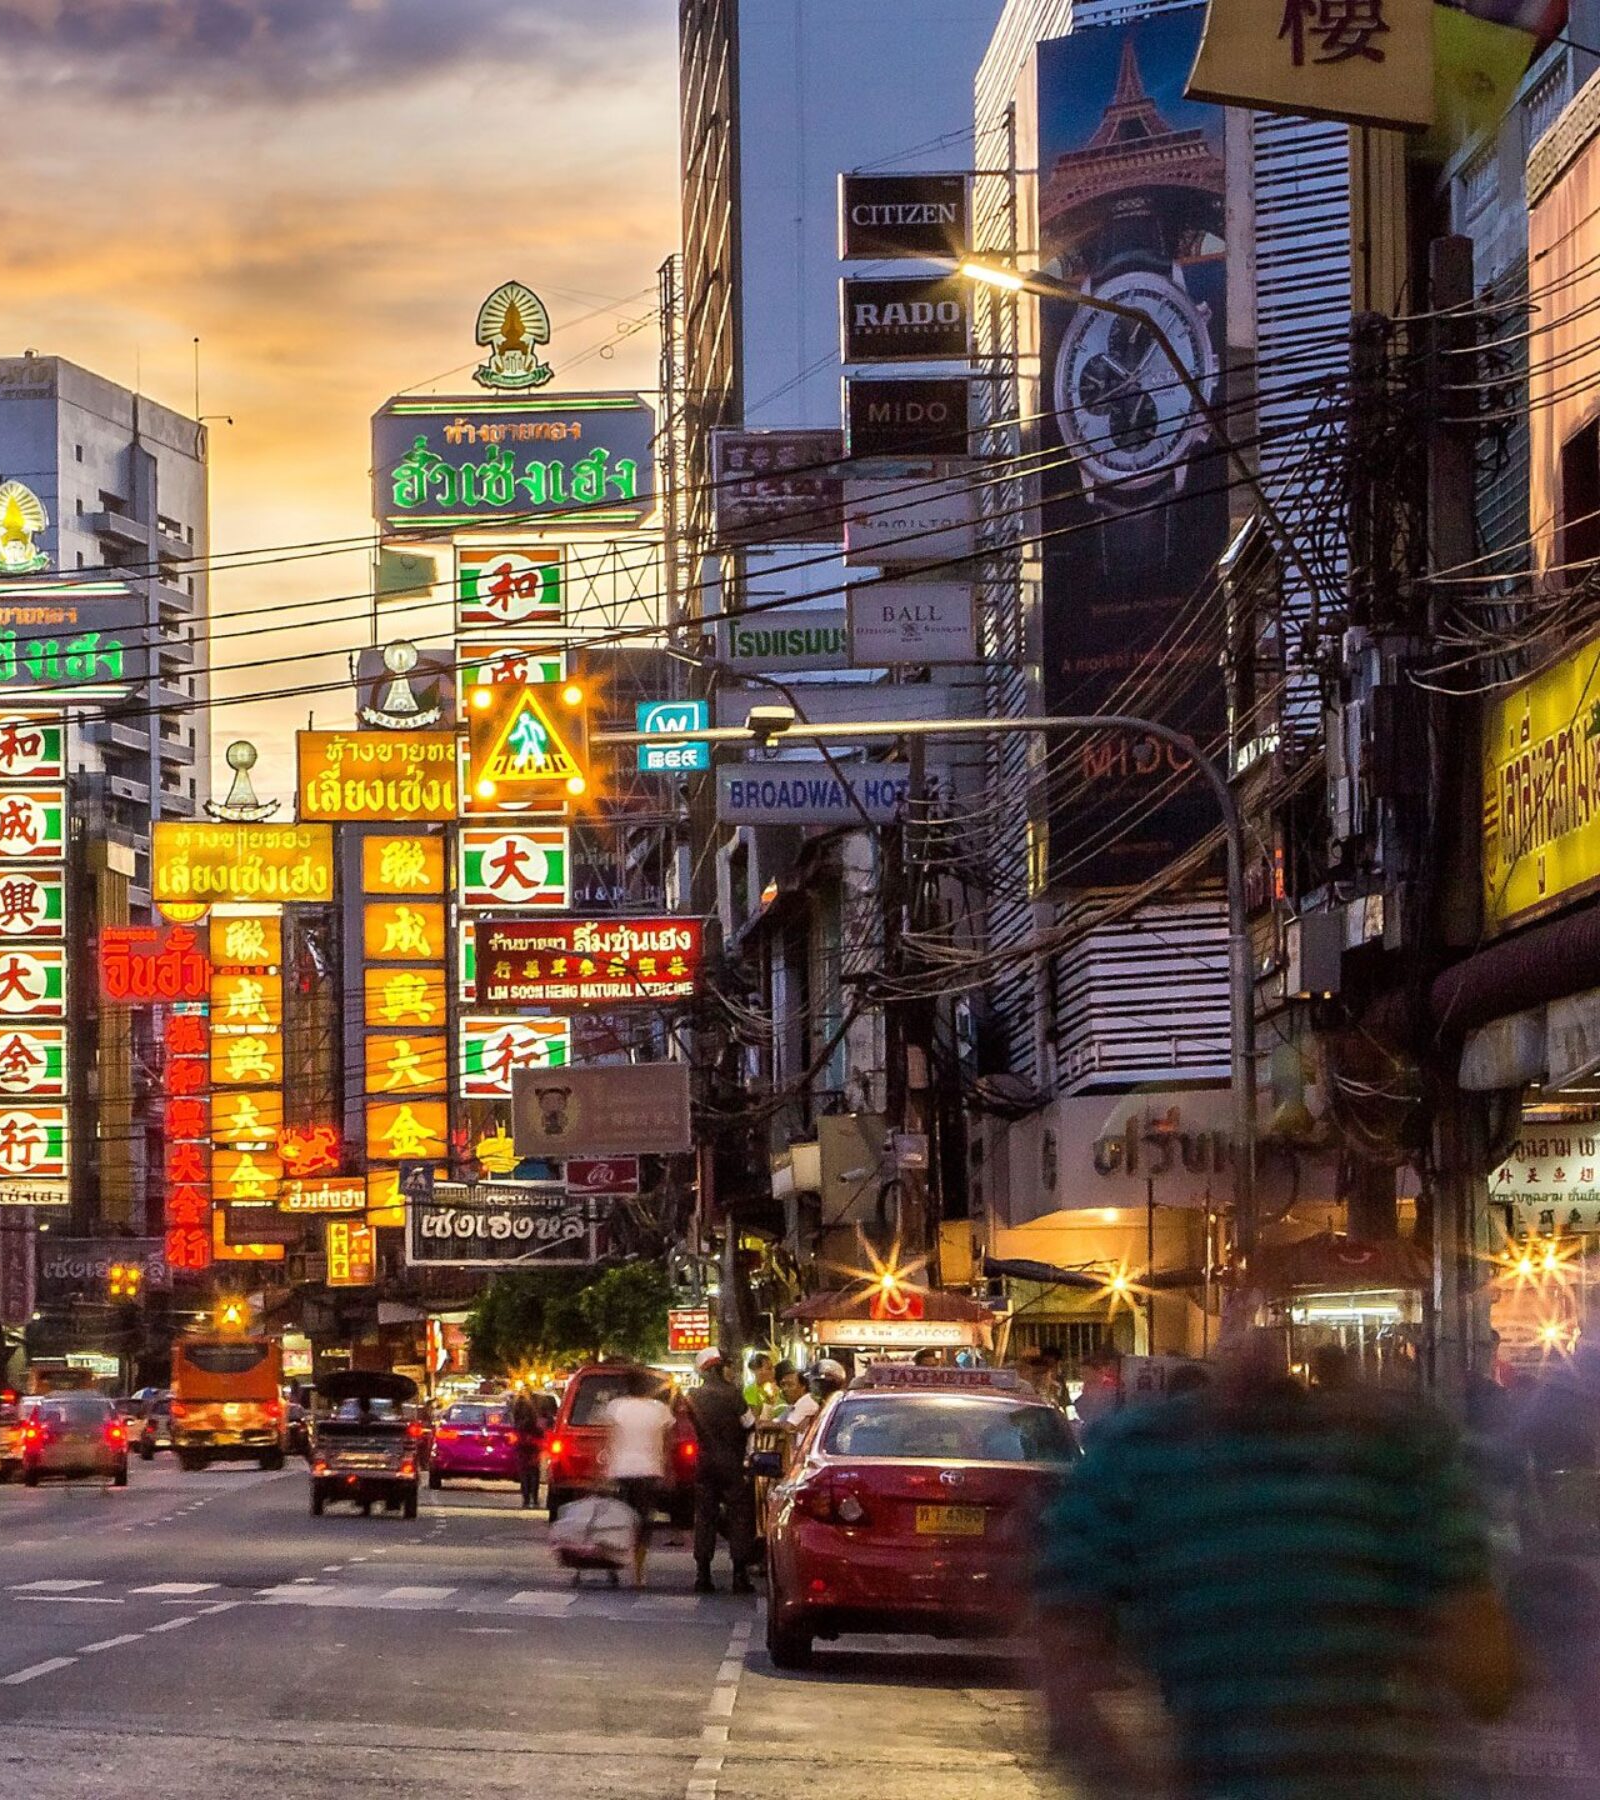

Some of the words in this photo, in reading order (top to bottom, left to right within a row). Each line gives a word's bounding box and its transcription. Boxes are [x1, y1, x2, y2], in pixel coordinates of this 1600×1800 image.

[852, 203, 958, 226] CITIZEN
[854, 301, 961, 326] RADO
[868, 402, 948, 423] MIDO
[443, 418, 583, 443] ห้างขายทอง
[882, 605, 944, 622] BALL
[326, 735, 456, 763] ห้างขายท
[647, 749, 699, 769] 屈臣氏
[306, 762, 457, 813] เลี่ยงเซ่งเ
[175, 827, 312, 850] ห้างขายทอง
[487, 983, 509, 1000] LIM
[510, 983, 544, 1000] SOON
[544, 982, 578, 999] HENG
[580, 980, 634, 998] NATURAL
[635, 980, 694, 997] MEDICINE
